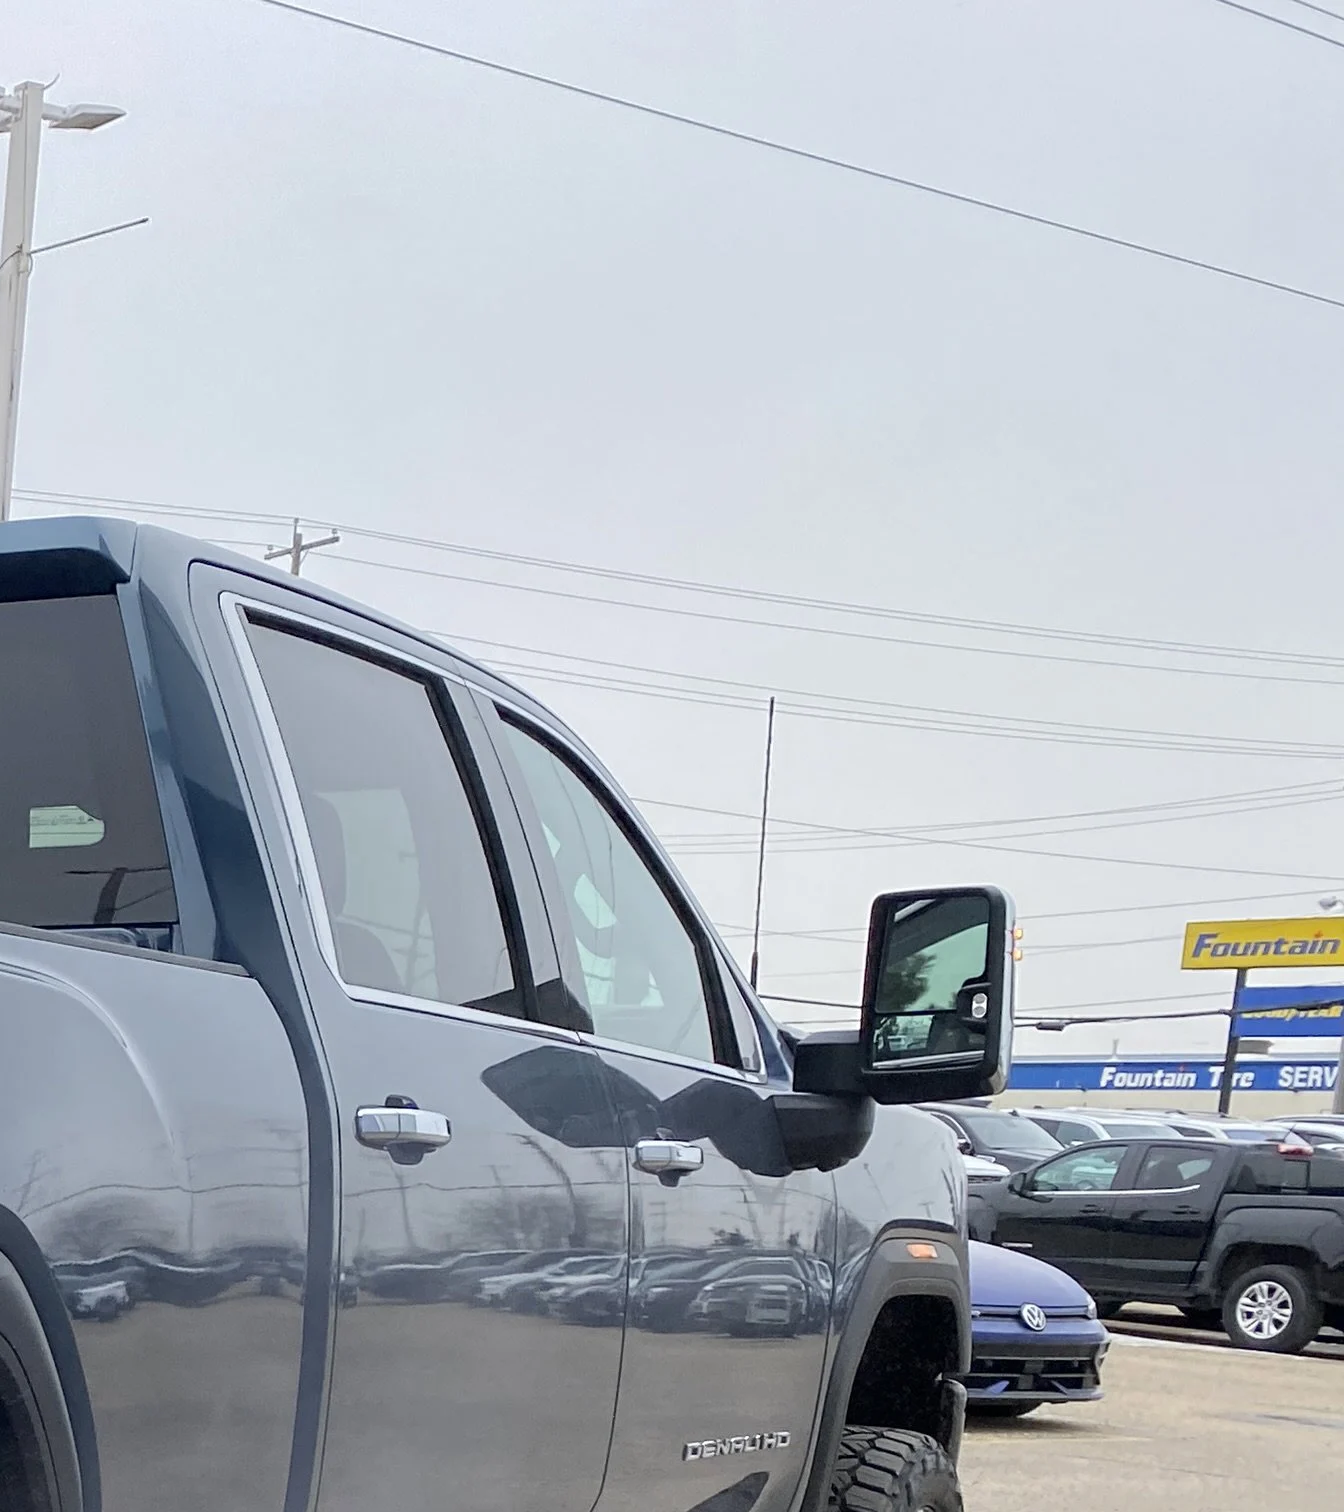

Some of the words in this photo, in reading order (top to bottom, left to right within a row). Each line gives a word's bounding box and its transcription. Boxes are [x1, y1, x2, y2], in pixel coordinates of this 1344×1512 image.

[1192, 930, 1341, 958] Fountain
[1099, 1065, 1197, 1088] Fountain
[1208, 1066, 1255, 1088] Tre
[683, 1435, 761, 1461] DENALI
[763, 1432, 791, 1450] HD
